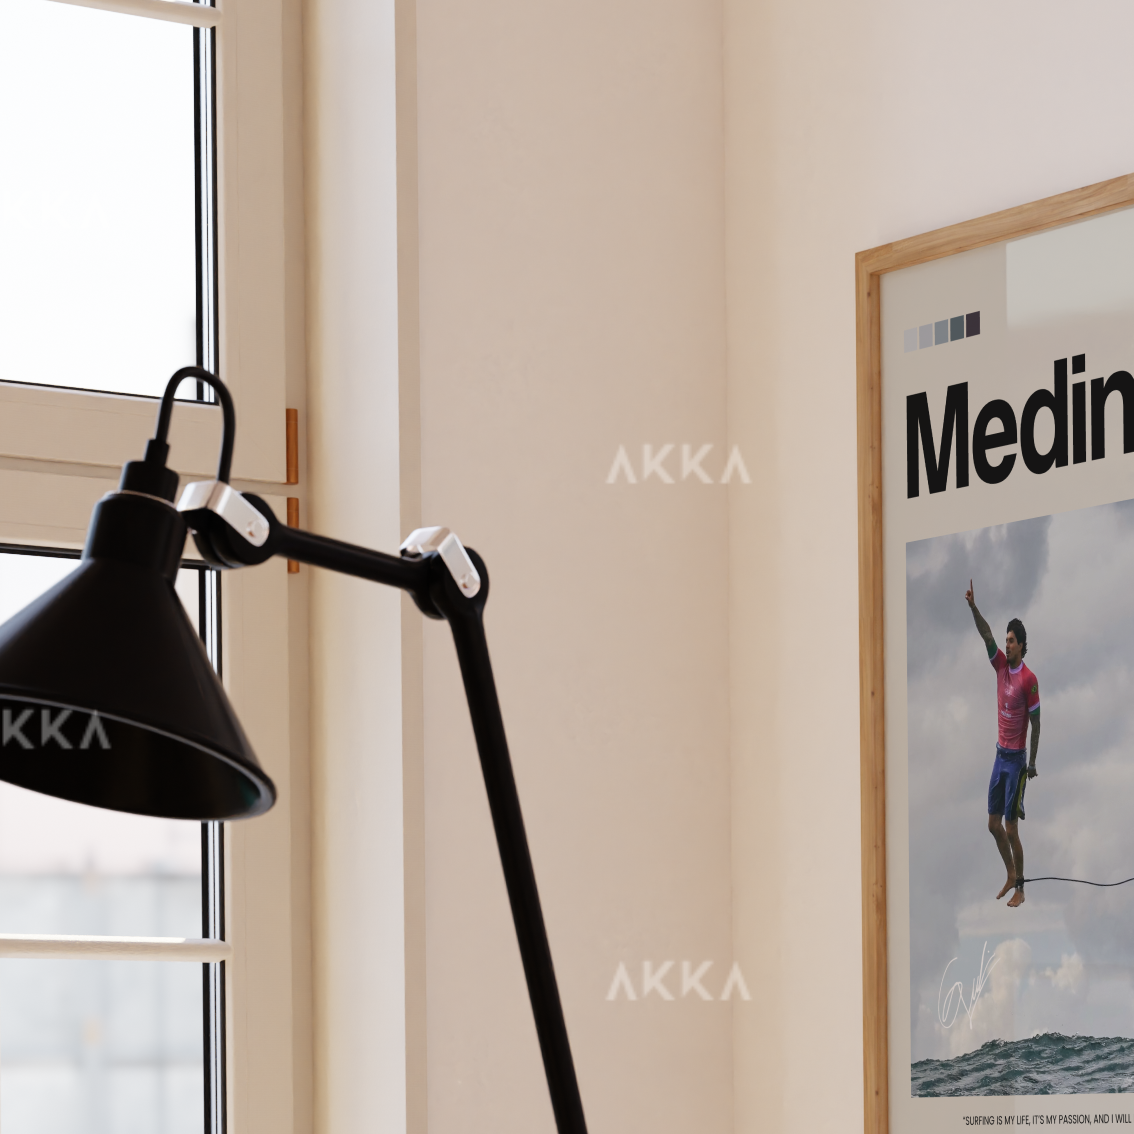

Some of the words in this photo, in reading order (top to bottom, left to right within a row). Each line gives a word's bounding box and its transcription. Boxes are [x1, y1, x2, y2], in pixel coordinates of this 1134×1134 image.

[996, 1115, 1003, 1125] IS
[1004, 1116, 1015, 1125] MY
[1016, 1115, 1031, 1126] LIFE,
[1045, 1115, 1057, 1124] MY
[1058, 1114, 1092, 1125] PASSION,
[1093, 1114, 1109, 1124] AND
[1114, 1114, 1132, 1123] WILL
